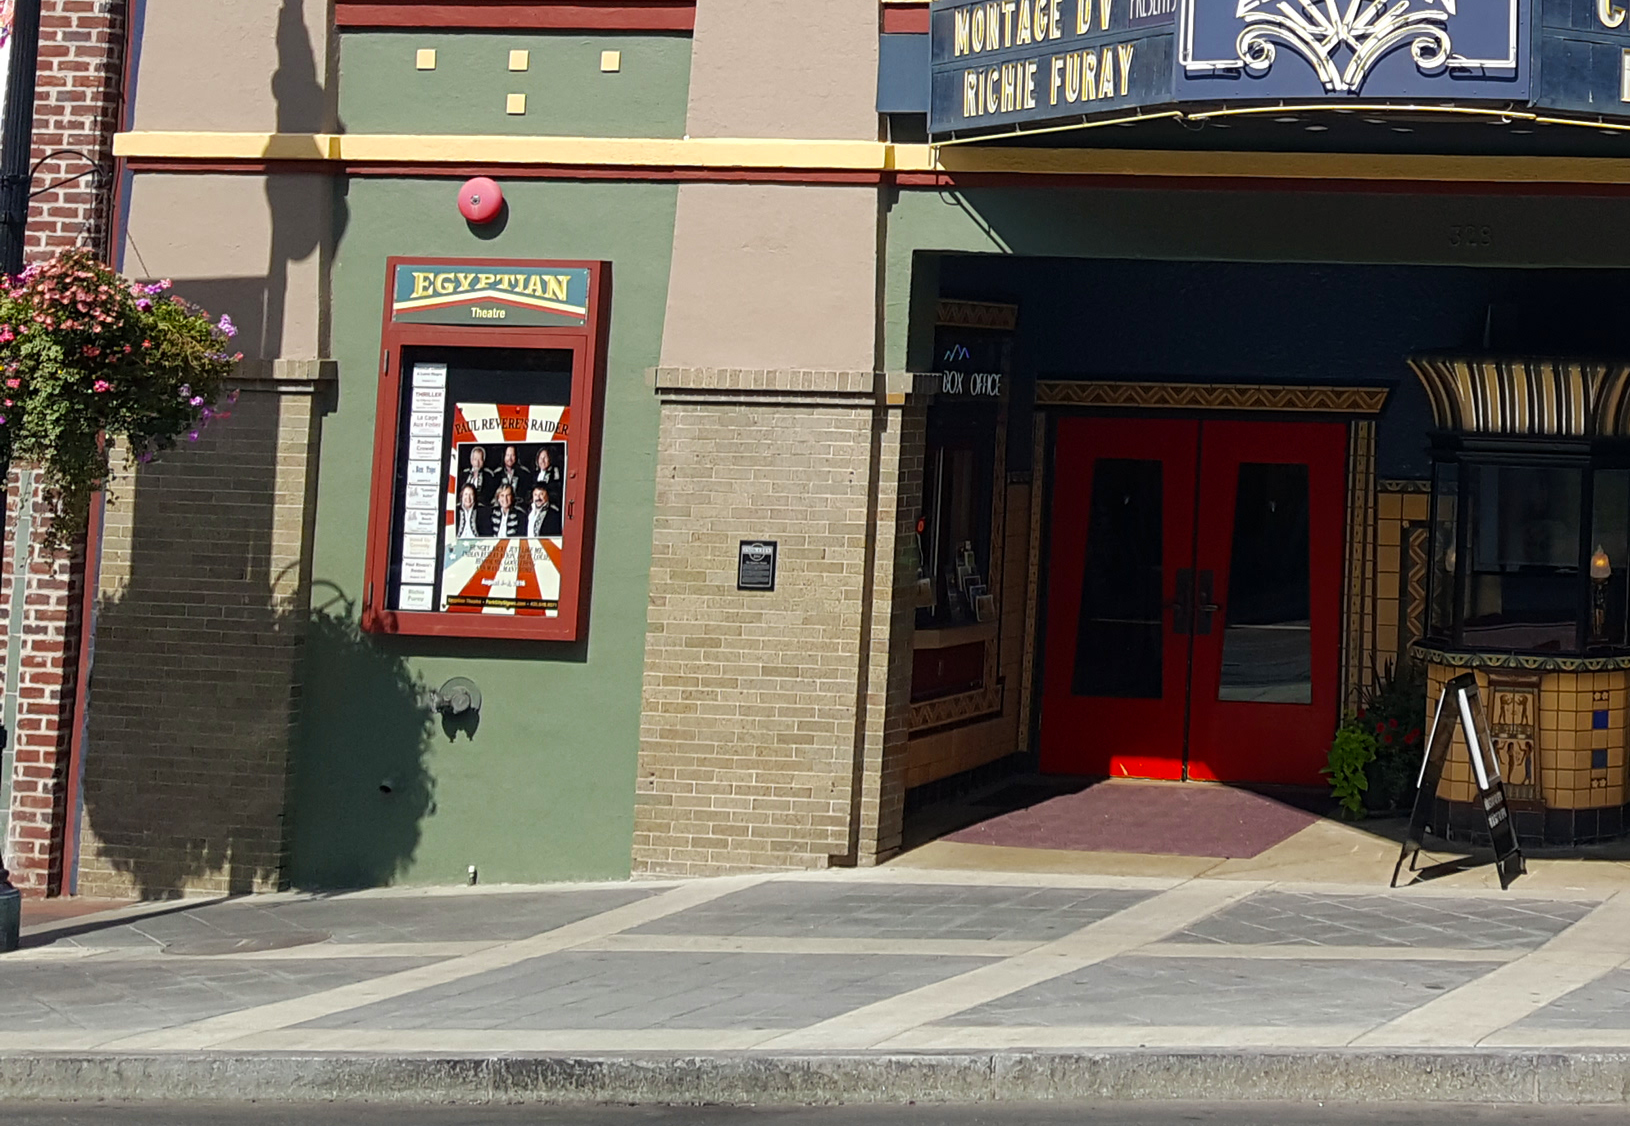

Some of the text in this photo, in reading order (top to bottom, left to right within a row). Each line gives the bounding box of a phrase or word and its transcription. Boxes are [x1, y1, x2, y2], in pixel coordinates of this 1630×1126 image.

[963, 44, 1134, 118] RICHIE FURAY
[409, 271, 572, 301] EGYPTIAN
[471, 307, 506, 319] Theatre
[942, 370, 1002, 396] BOX OFFICE
[455, 419, 480, 435] PAUL
[481, 417, 529, 431] REVERE'S
